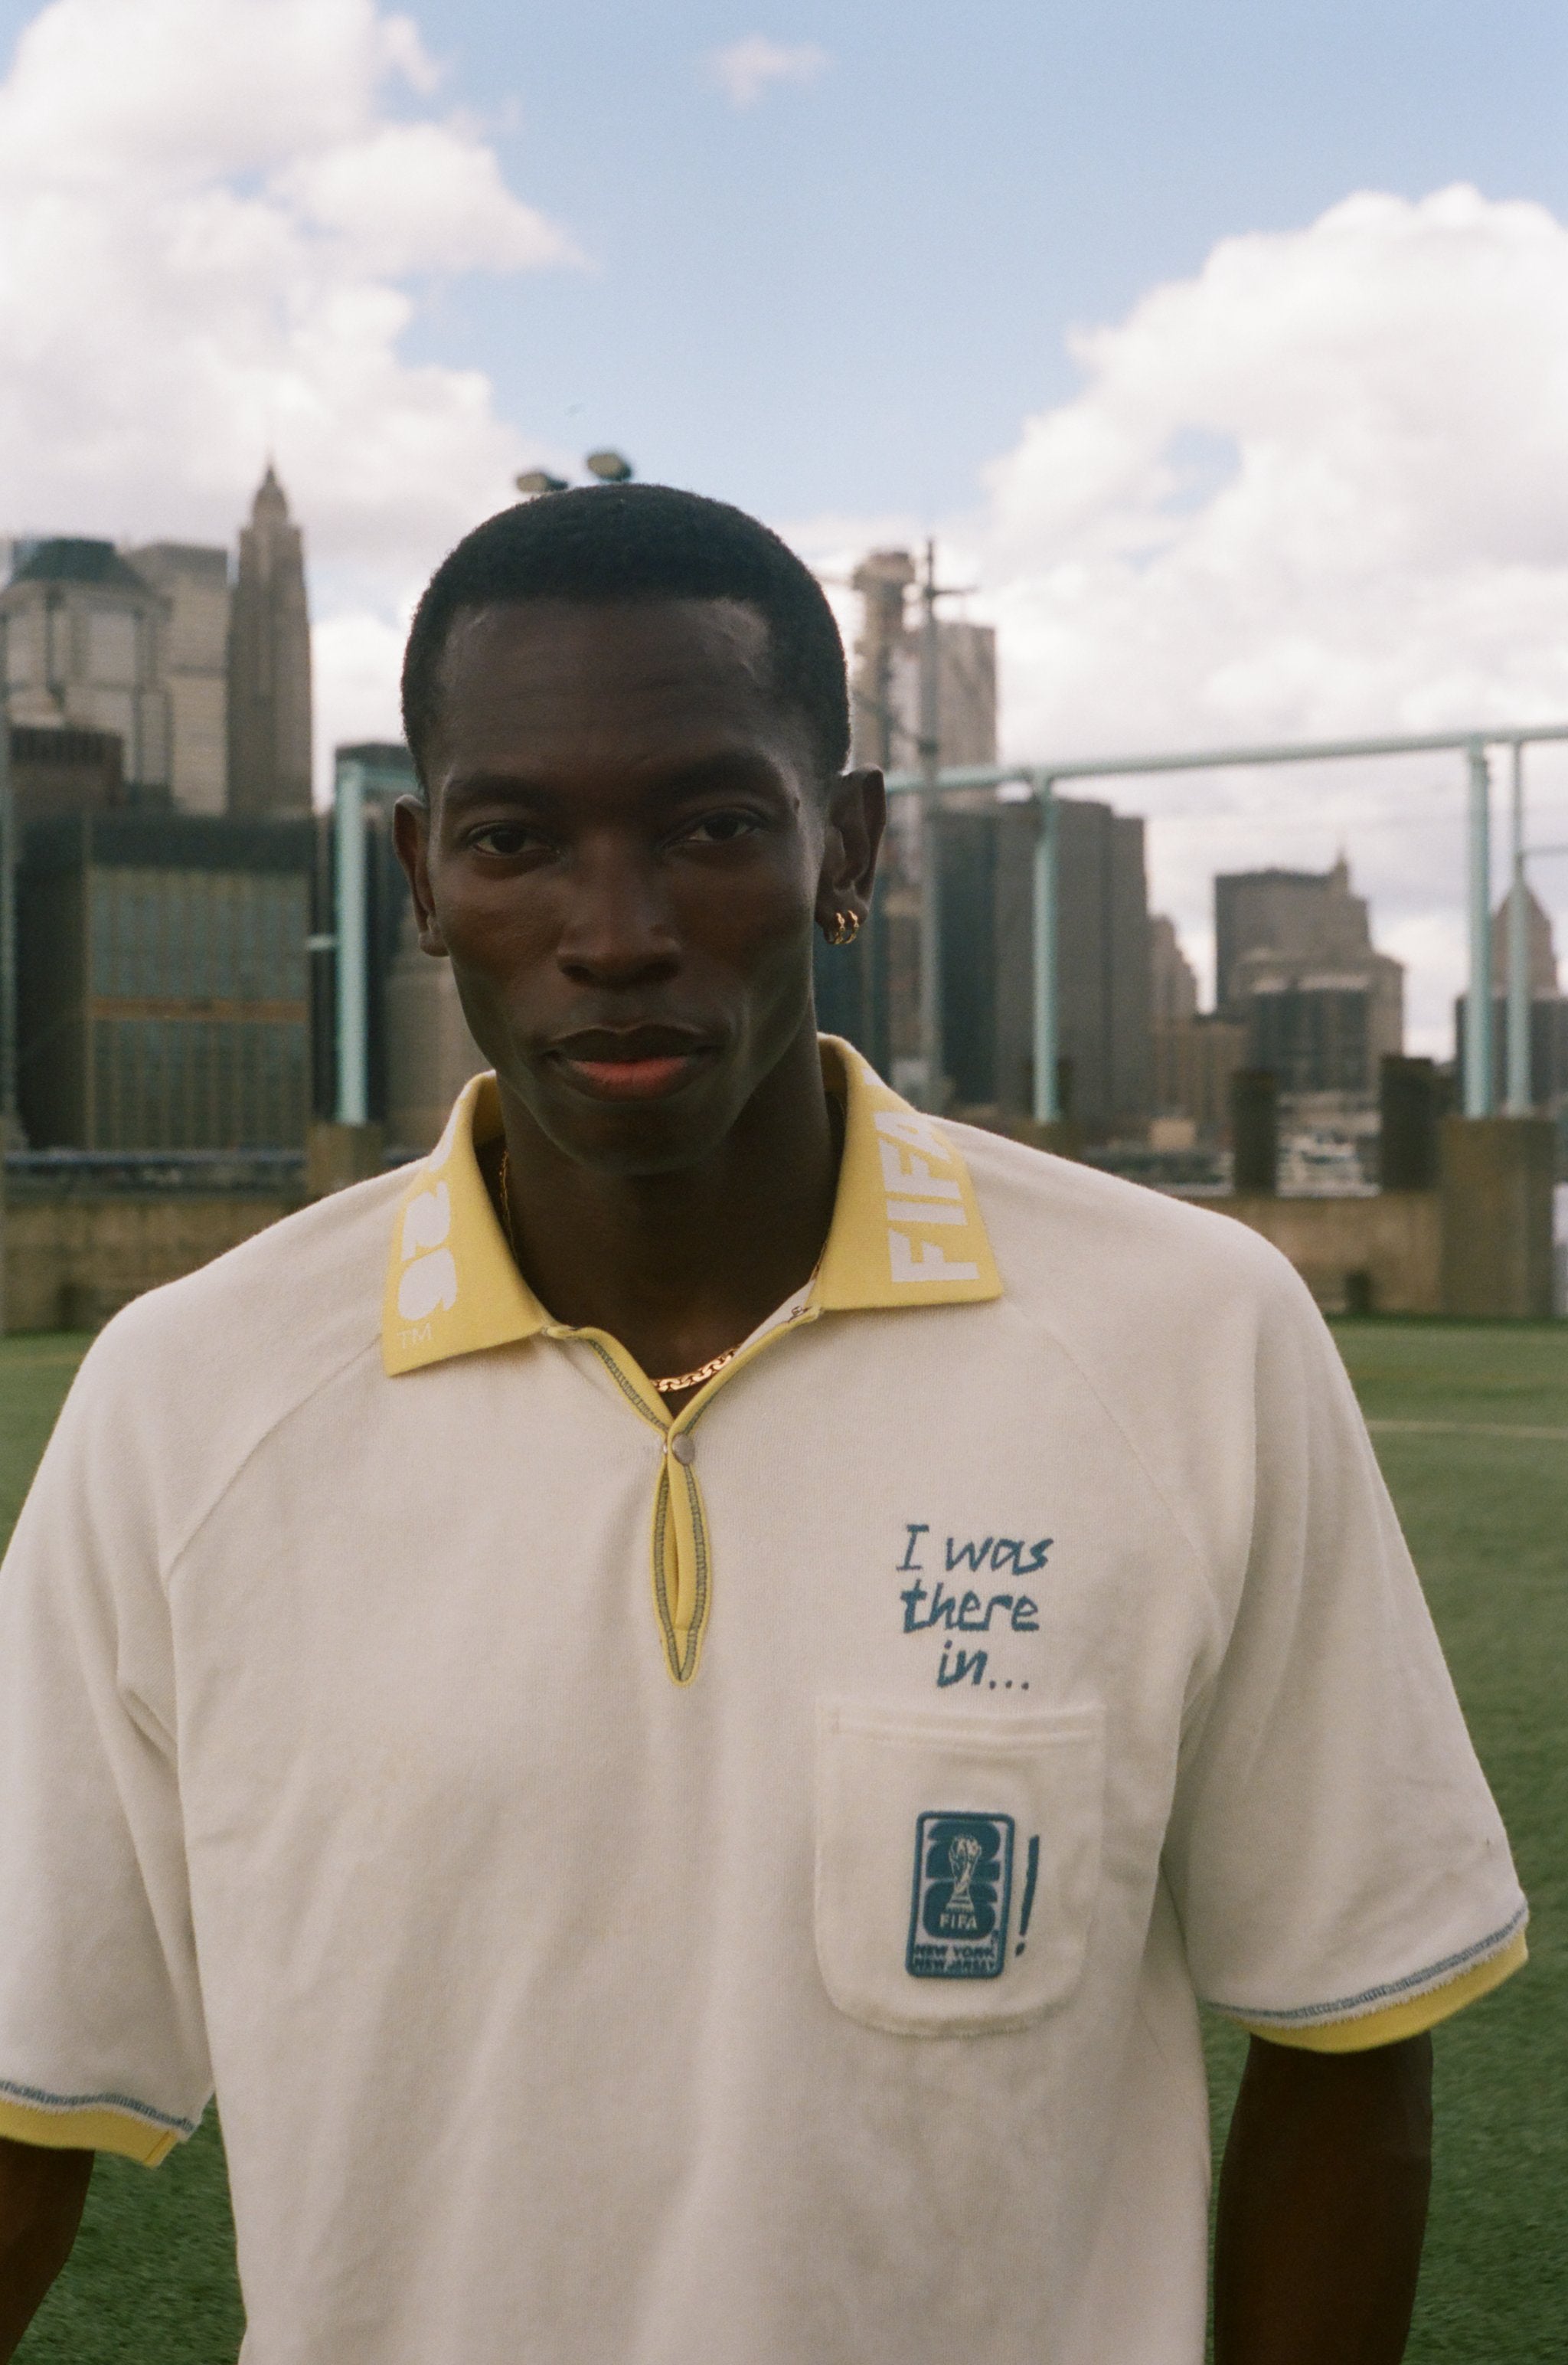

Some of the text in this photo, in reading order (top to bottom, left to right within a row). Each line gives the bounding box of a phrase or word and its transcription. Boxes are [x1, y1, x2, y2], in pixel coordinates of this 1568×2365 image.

[874, 1112, 980, 1283] FIFA
[897, 1524, 1054, 1575] I was
[900, 1578, 1040, 1634] there
[937, 1640, 1030, 1690] in...
[939, 1914, 978, 1929] FIFA
